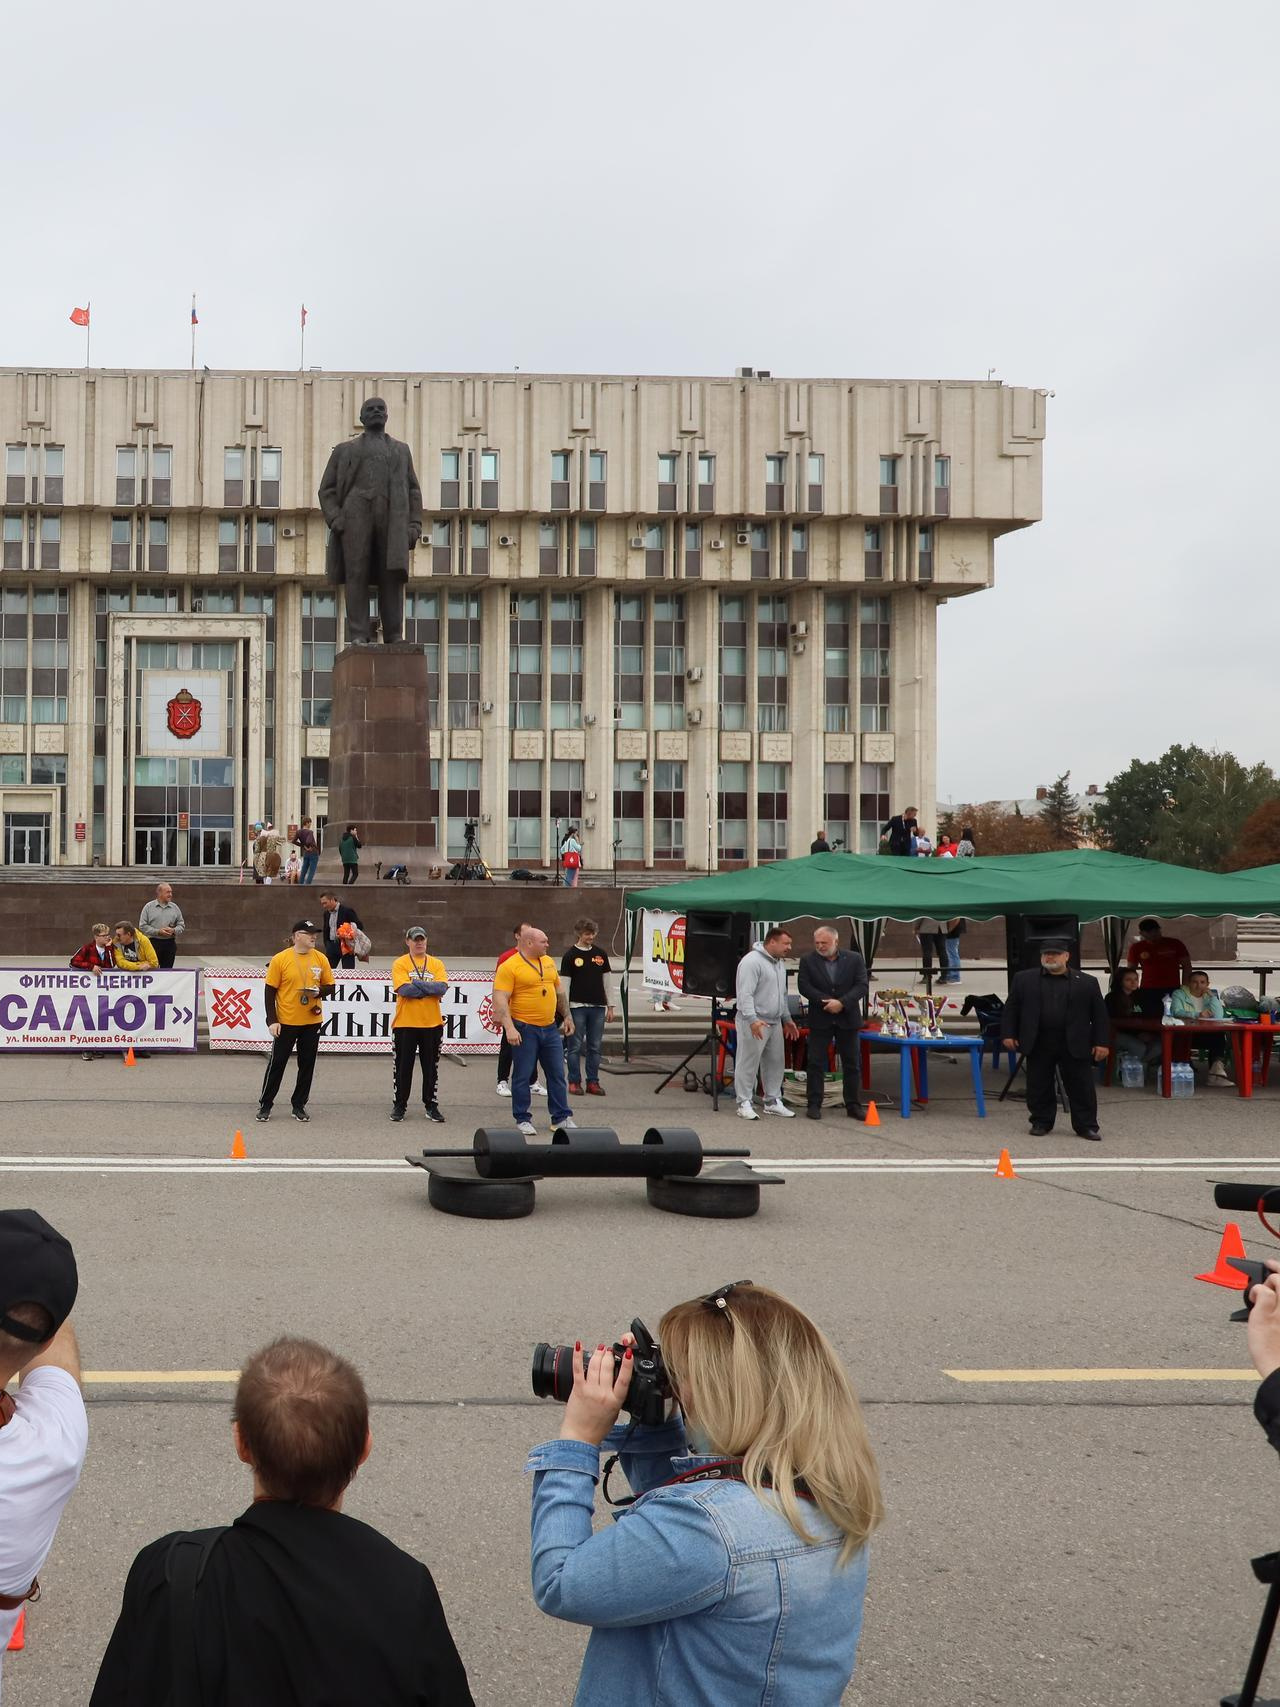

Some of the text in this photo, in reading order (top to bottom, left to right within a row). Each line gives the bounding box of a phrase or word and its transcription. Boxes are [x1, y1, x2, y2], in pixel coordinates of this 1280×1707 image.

[20, 974, 154, 991] ФИТНЕС ЦЕНТР
[6, 1035, 19, 1044] ул.
[22, 1034, 66, 1043] Николая
[69, 1034, 113, 1044] Руднева
